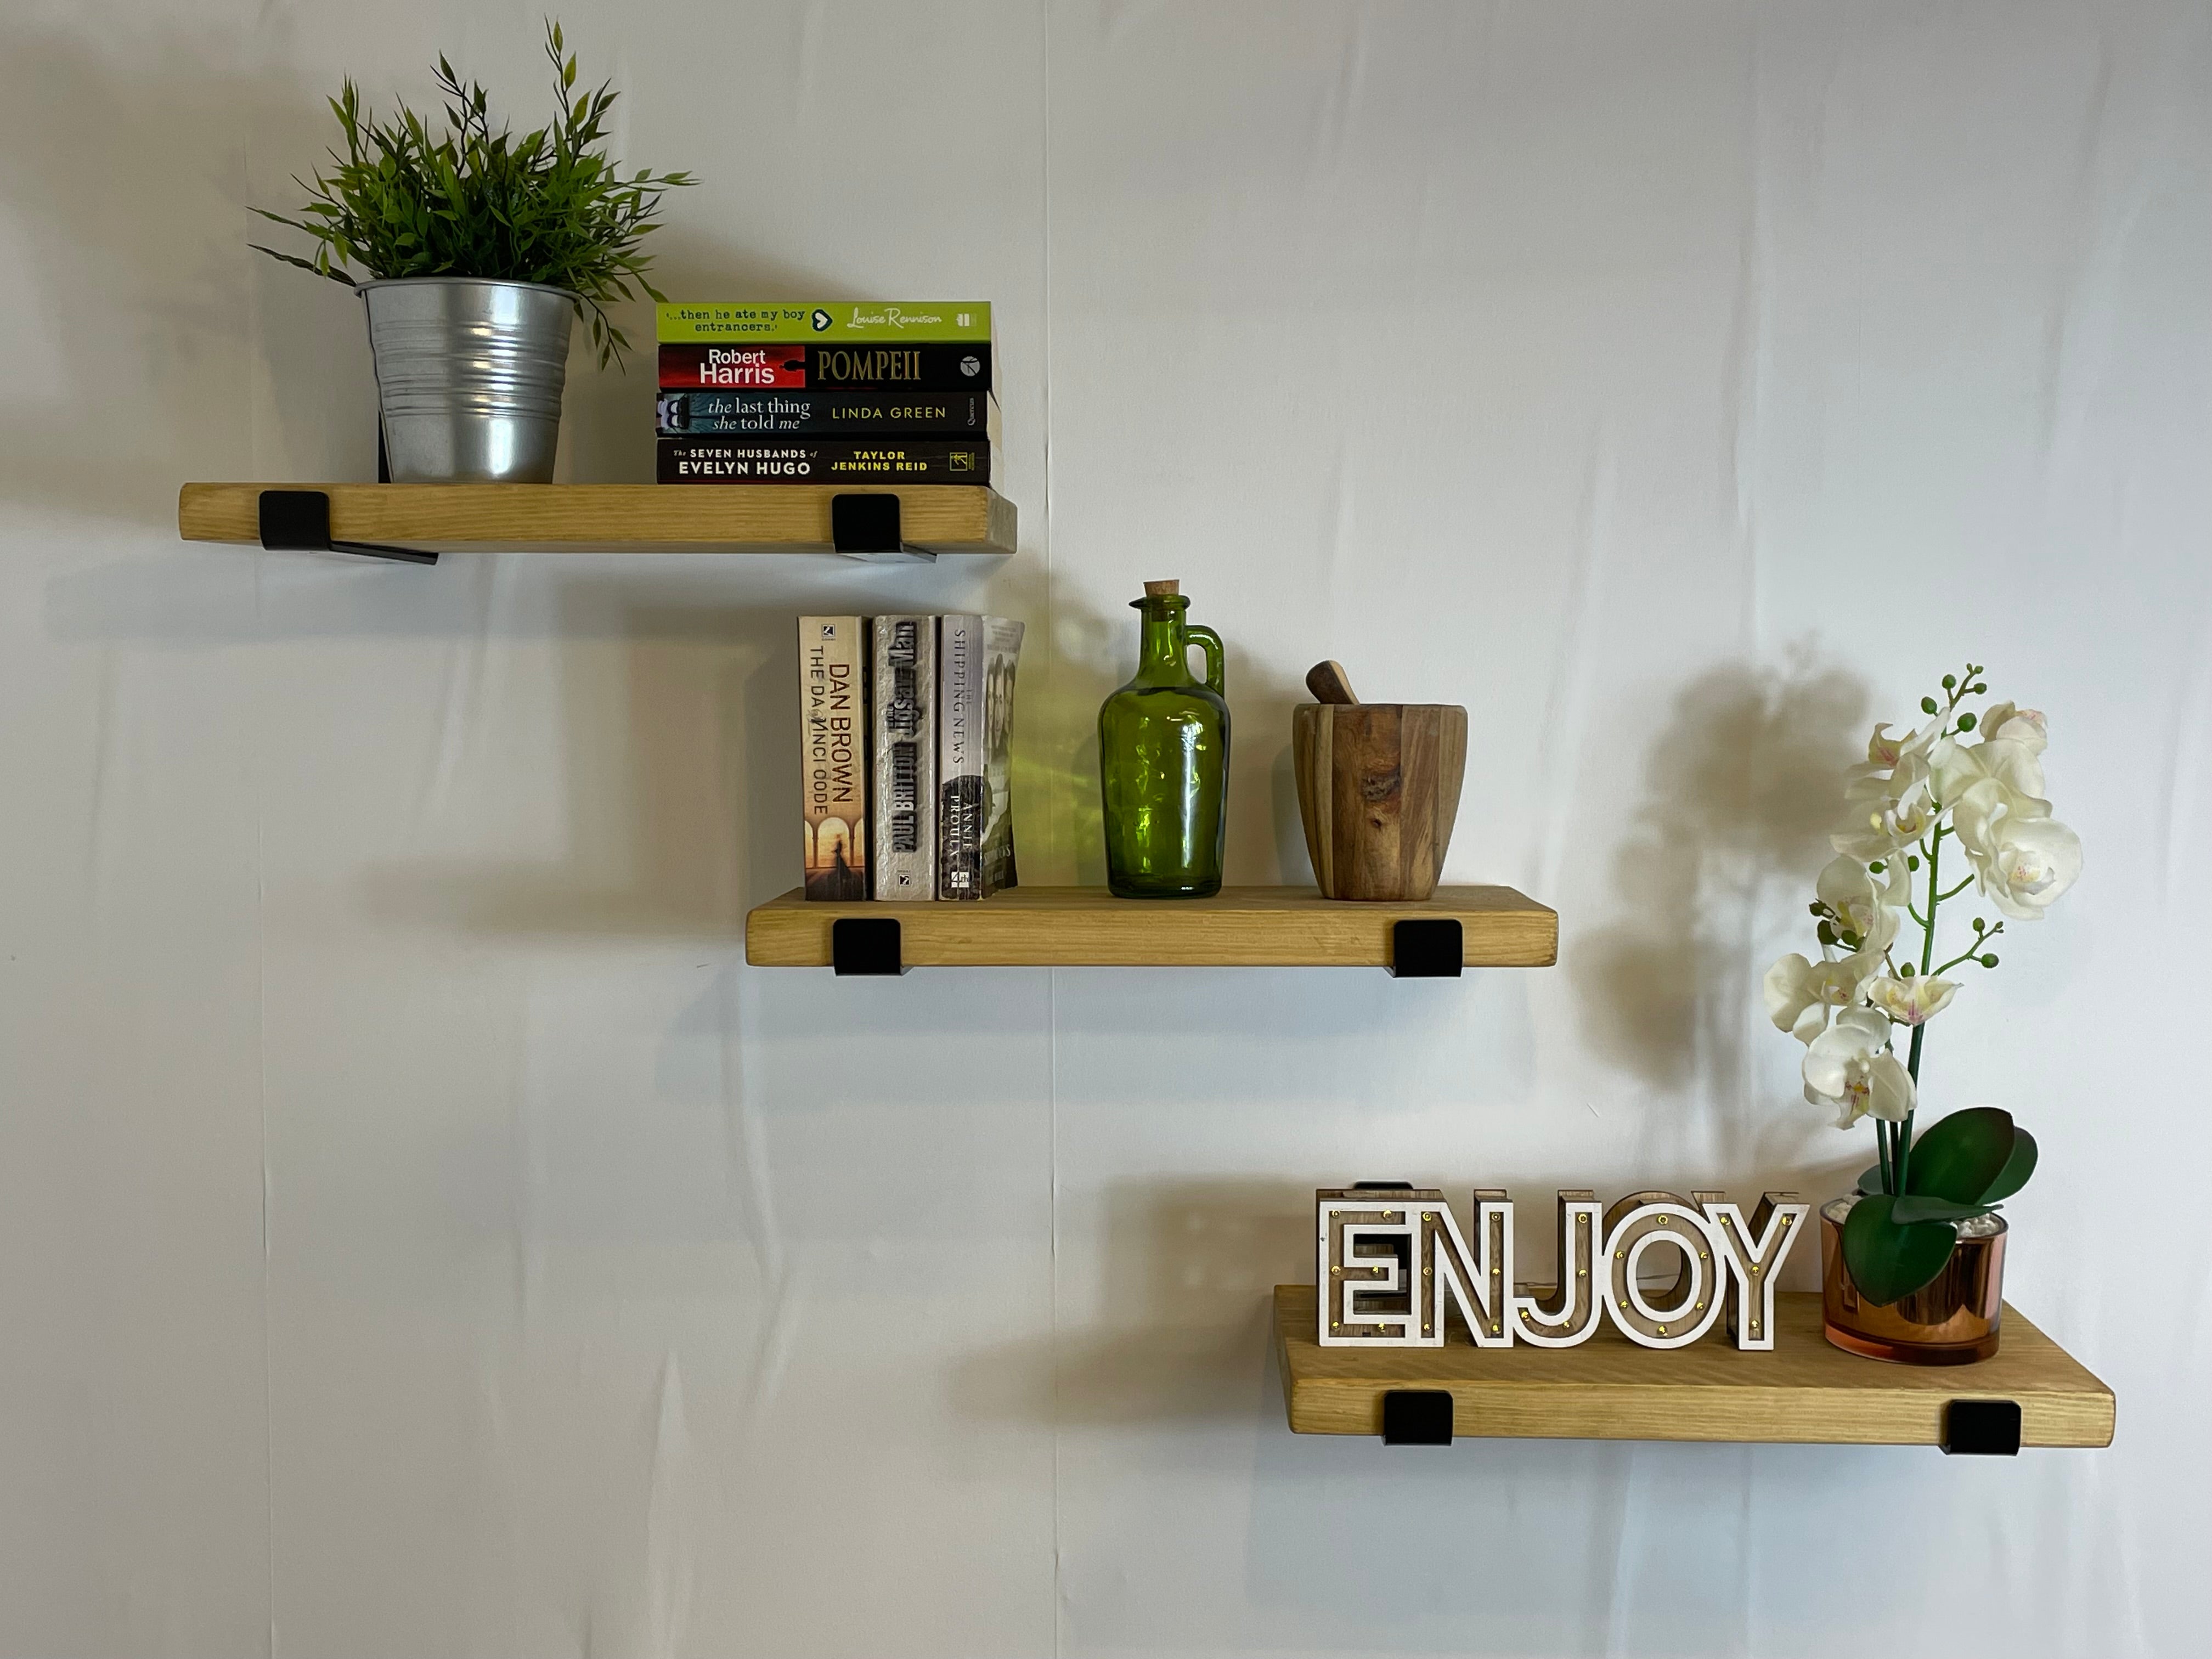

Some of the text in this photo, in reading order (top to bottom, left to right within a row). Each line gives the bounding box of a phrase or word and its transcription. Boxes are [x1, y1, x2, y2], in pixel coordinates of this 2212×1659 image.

[715, 309, 730, 319] he
[735, 309, 757, 319] ate
[761, 309, 778, 320] my
[783, 309, 805, 320] boy
[847, 307, 942, 329] Louise Rennison
[708, 349, 766, 364] Robert
[817, 351, 922, 380] POMPEII
[699, 363, 775, 384] Harris
[709, 397, 811, 419] the last thing
[832, 407, 946, 419] LINDA GREEN
[713, 415, 800, 430] she told me
[690, 449, 731, 458] SEVEN
[737, 449, 806, 459] HUSBANDS
[809, 450, 819, 458] of
[831, 461, 927, 471] JENKINS REID
[853, 451, 905, 460] TAYLOR
[679, 461, 811, 475] EVELYN HUGO
[888, 623, 915, 667] Man
[810, 646, 825, 679] THE
[811, 686, 825, 708] DA
[829, 664, 850, 710] DAN
[952, 629, 966, 764] SHIPPING NEWS
[831, 717, 853, 802] BROWN
[893, 746, 915, 811] BRITTON
[813, 769, 828, 815] CODE
[893, 815, 915, 853] PAUL
[950, 795, 960, 856] PROULX
[963, 802, 973, 850] ANNIE
[1318, 1197, 1810, 1351] ENJOY
